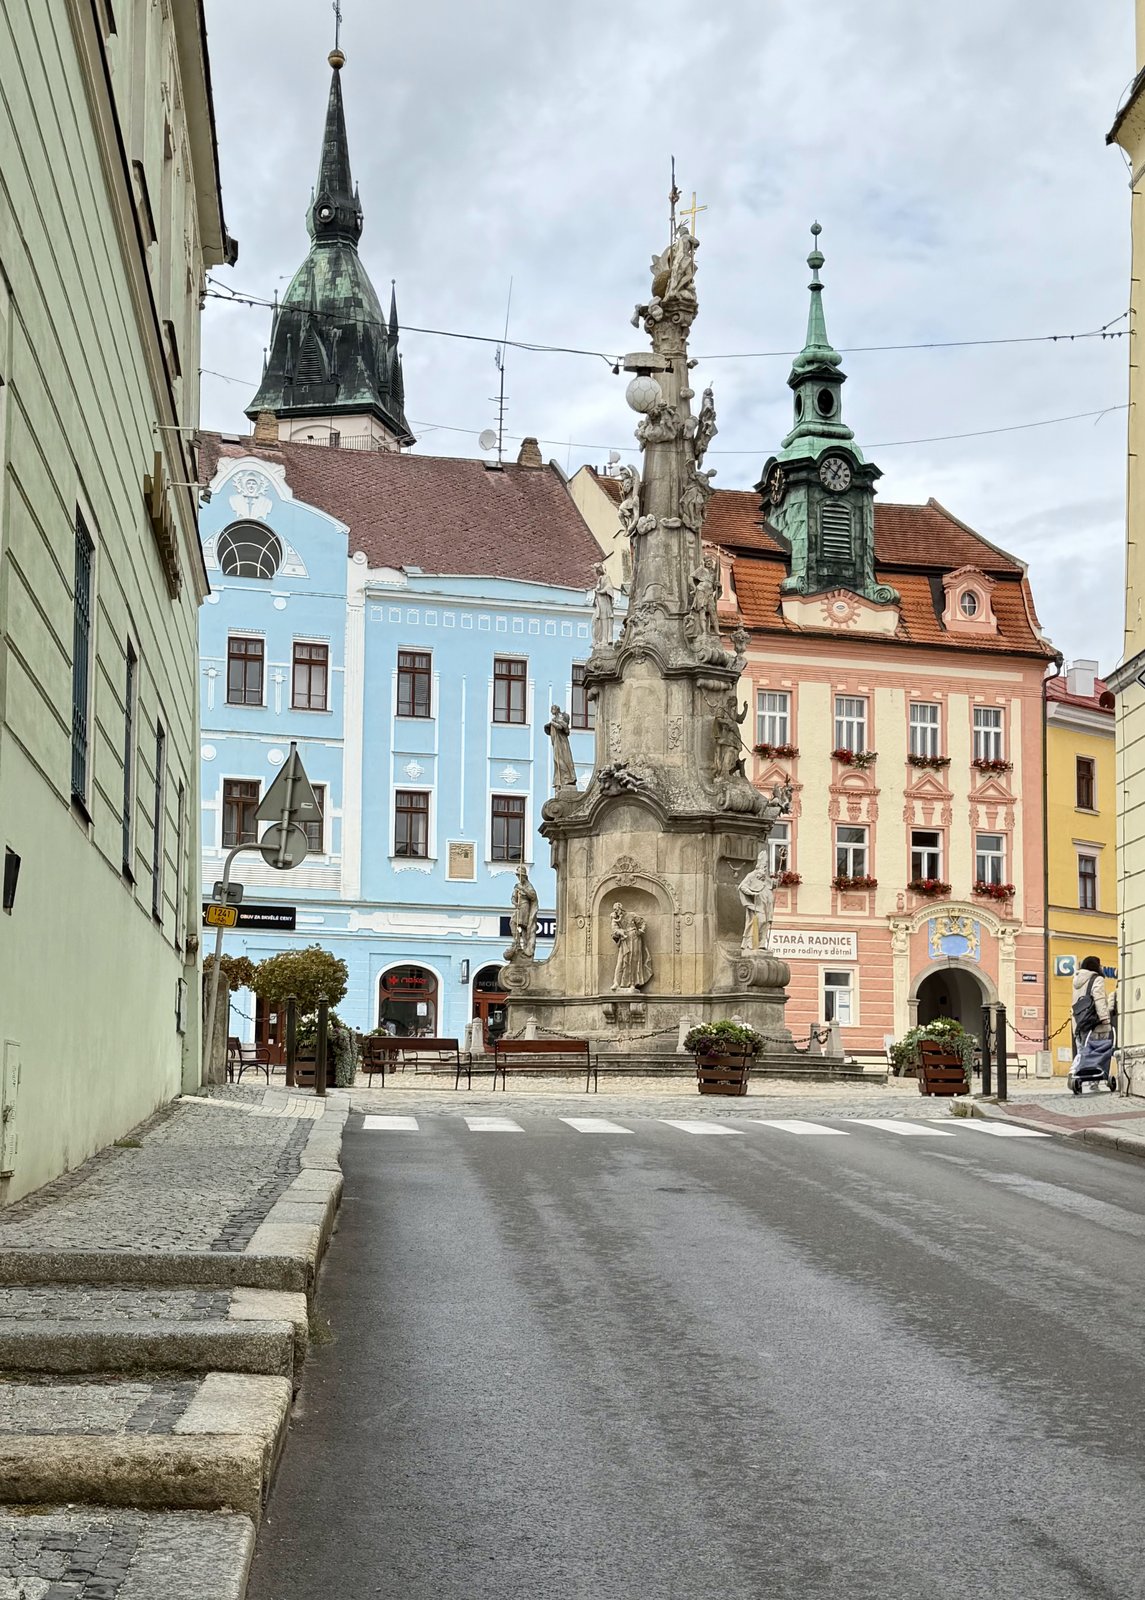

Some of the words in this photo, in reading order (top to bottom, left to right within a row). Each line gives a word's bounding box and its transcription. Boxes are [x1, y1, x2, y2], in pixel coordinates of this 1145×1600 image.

[214, 908, 230, 917] 1241
[772, 933, 805, 944] STARÁ
[808, 936, 852, 945] RADNICE
[798, 947, 823, 956] rodiny
[830, 947, 852, 956] dětmi
